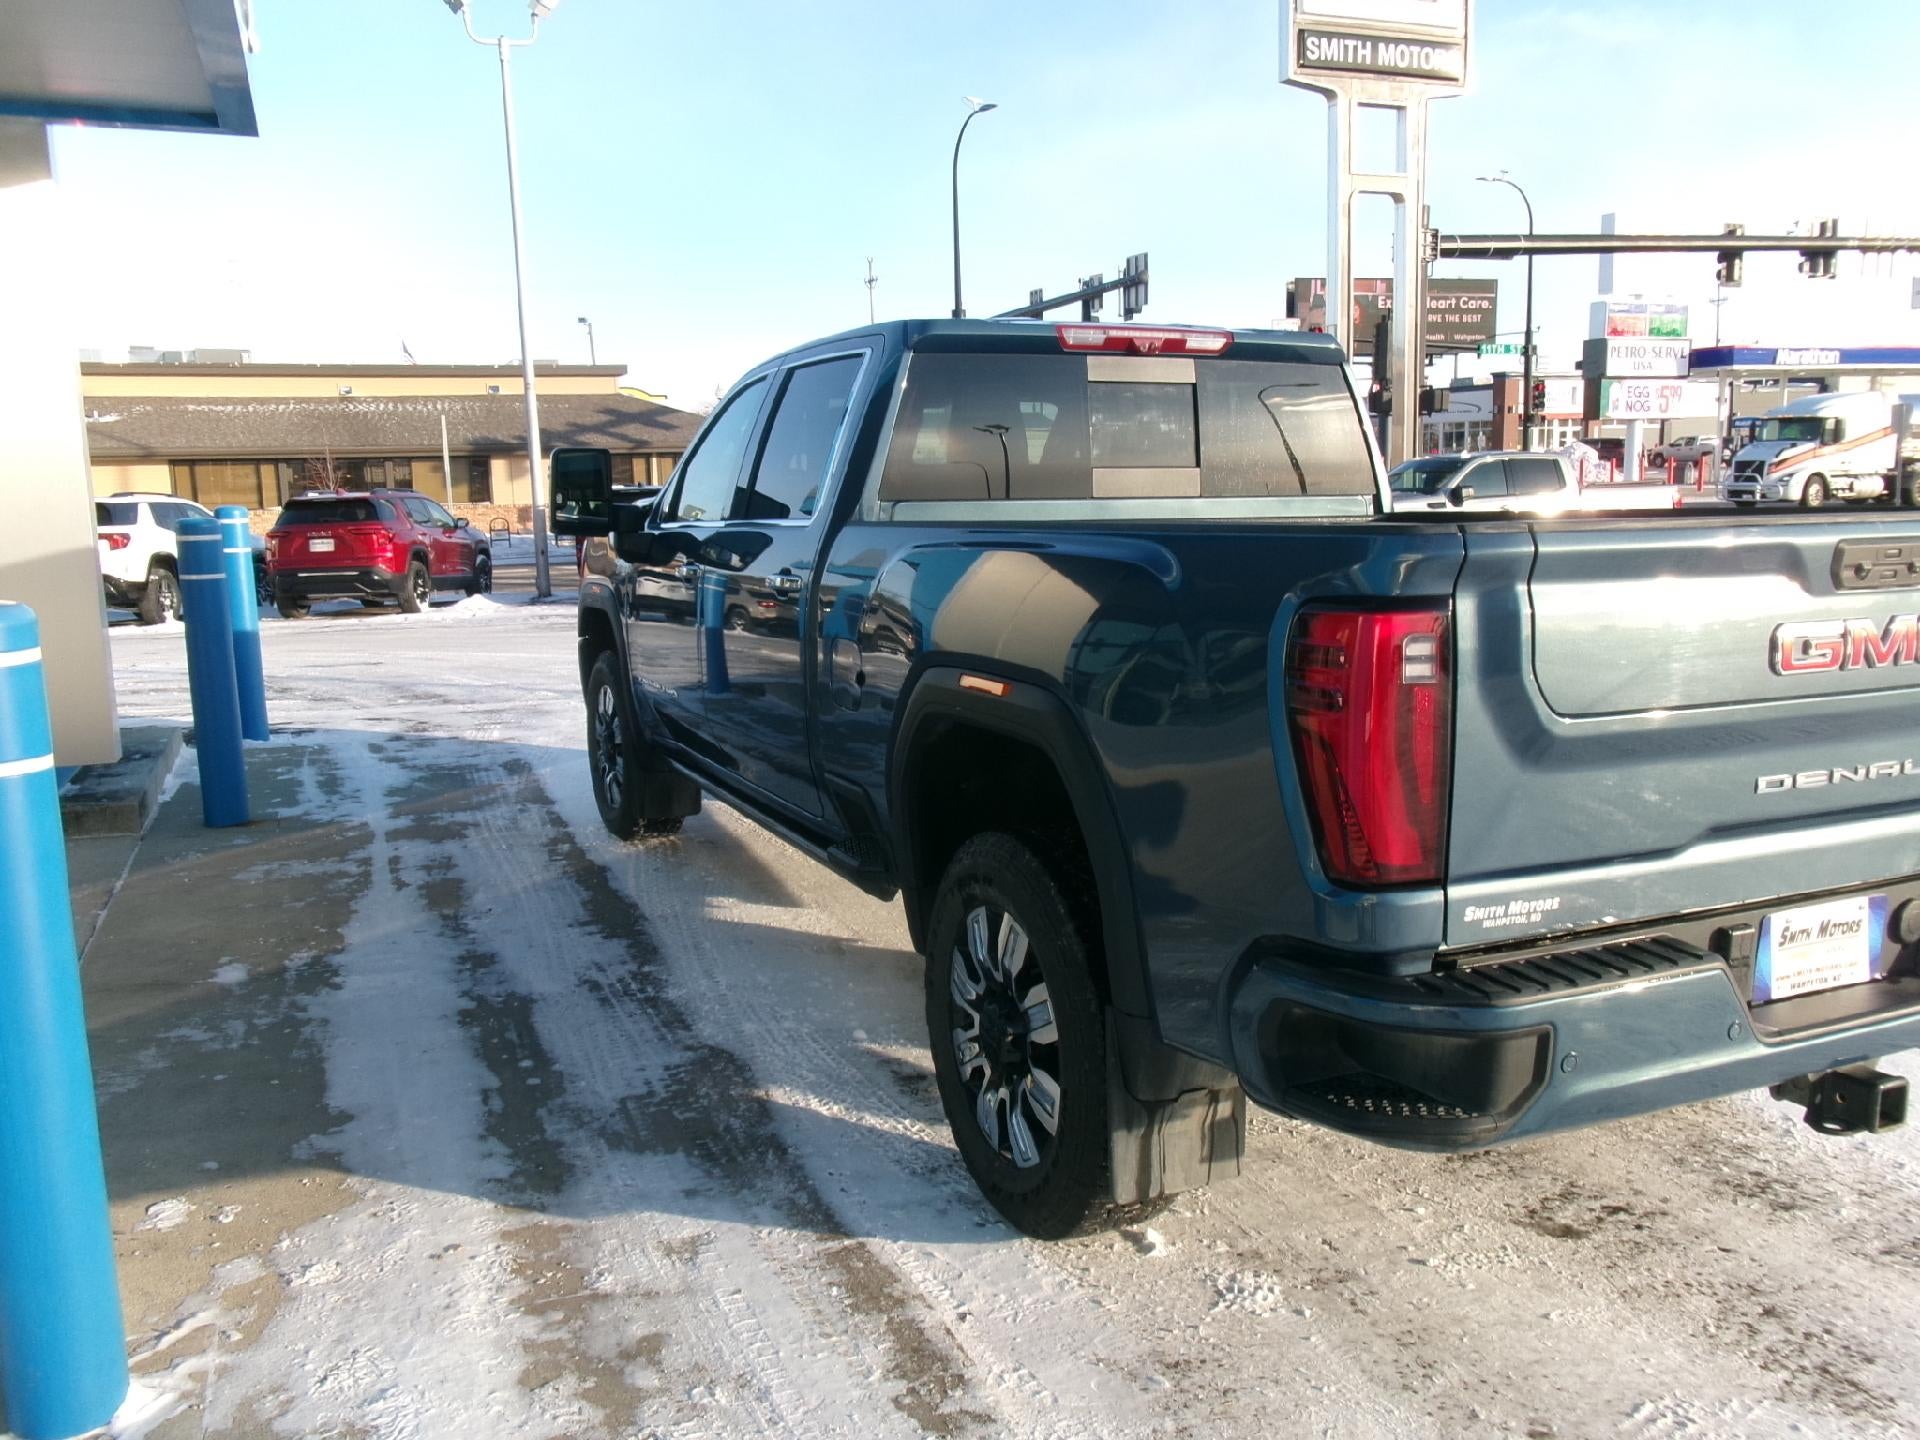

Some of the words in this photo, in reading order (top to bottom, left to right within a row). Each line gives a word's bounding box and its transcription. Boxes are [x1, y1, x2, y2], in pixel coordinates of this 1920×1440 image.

[1306, 36, 1371, 64] SMITH
[1378, 42, 1457, 72] MOTO
[1460, 297, 1493, 310] Care.
[1445, 314, 1460, 323] THE
[1462, 314, 1482, 323] BEST
[1425, 333, 1445, 341] ealth
[1481, 343, 1504, 354] 11TH
[1610, 346, 1688, 359] PETRO-SERVE
[1633, 361, 1653, 371] USA
[1627, 385, 1650, 399] EGG
[1625, 400, 1651, 413] NOG
[1768, 614, 1920, 676] GM
[1754, 758, 1920, 794] DENAL
[1463, 904, 1506, 922] SMITH
[1508, 896, 1561, 915] MOTORS
[1778, 924, 1812, 947] SMITH
[1816, 918, 1863, 939] MOTORS
